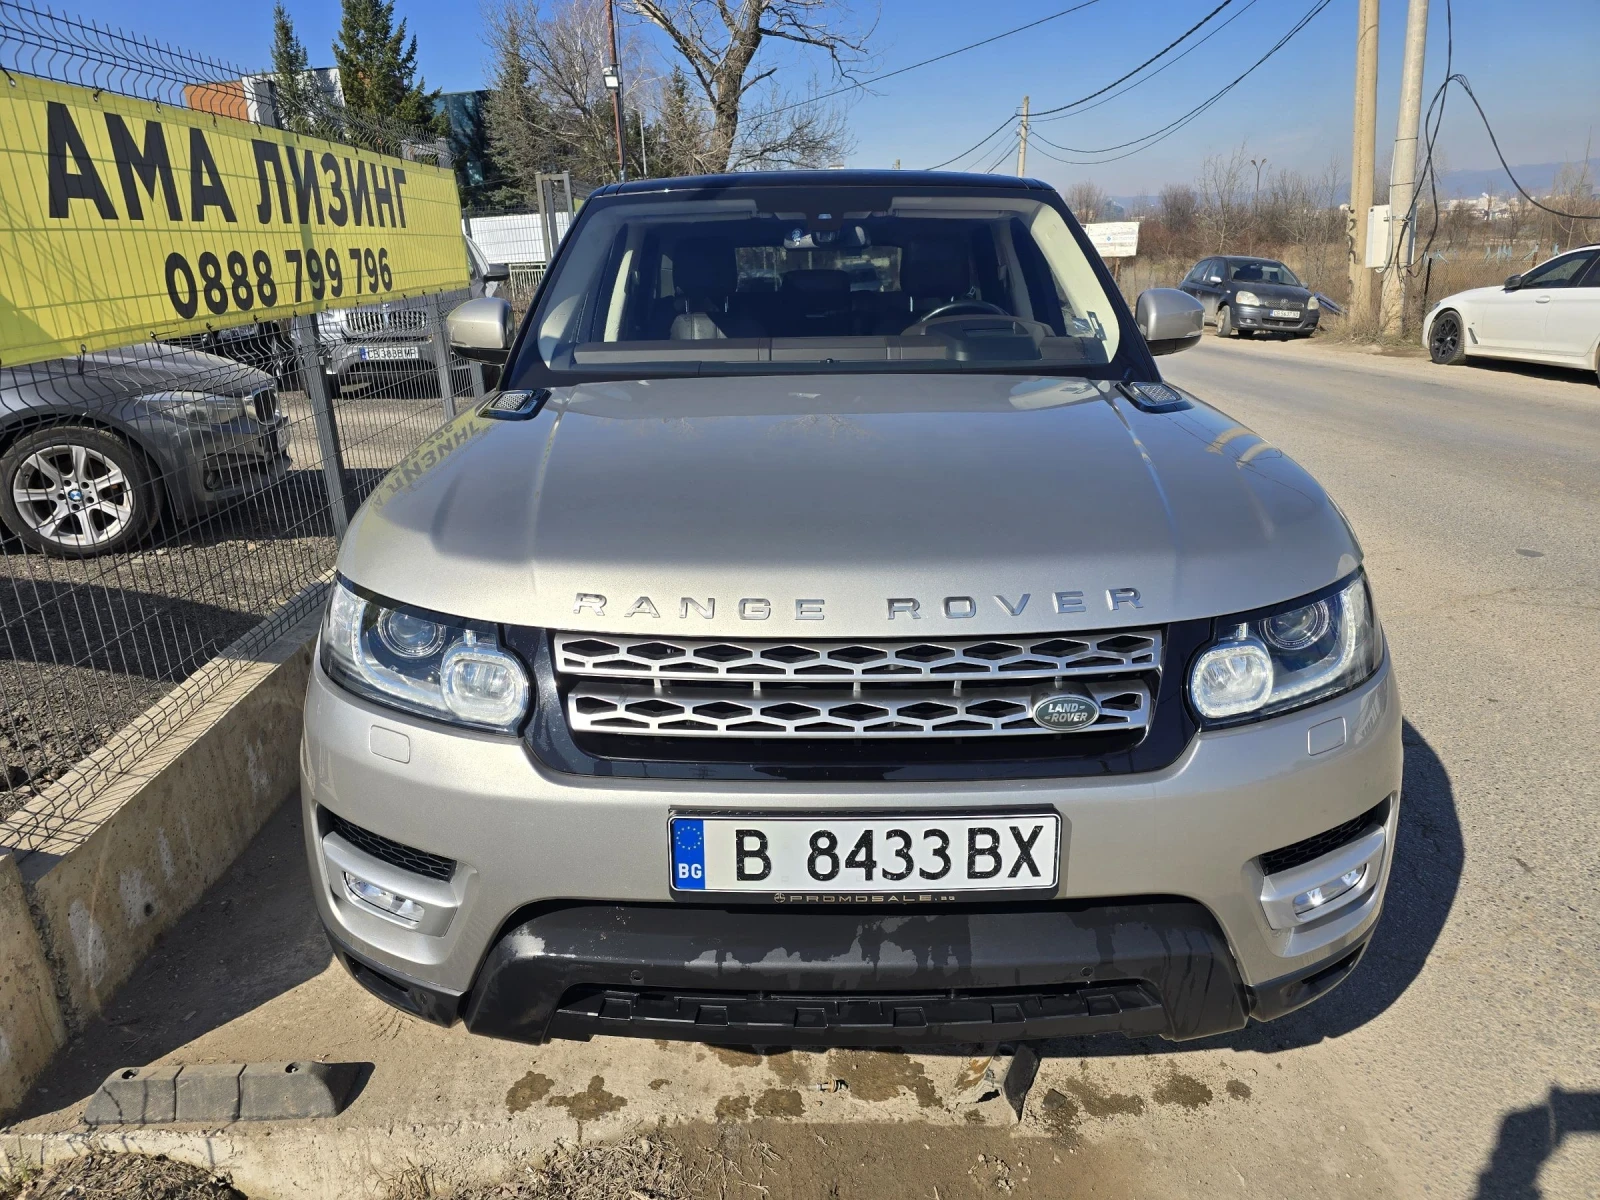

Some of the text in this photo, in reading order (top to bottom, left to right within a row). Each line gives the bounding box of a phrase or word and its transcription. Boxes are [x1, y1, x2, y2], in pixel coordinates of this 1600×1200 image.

[47, 101, 407, 229] АМА ЛИЗИНГ
[164, 247, 393, 320] 0888 799 796
[572, 586, 1145, 621] RANGE ROVER
[678, 862, 702, 879] BG
[734, 825, 1044, 882] B 8433 BX
